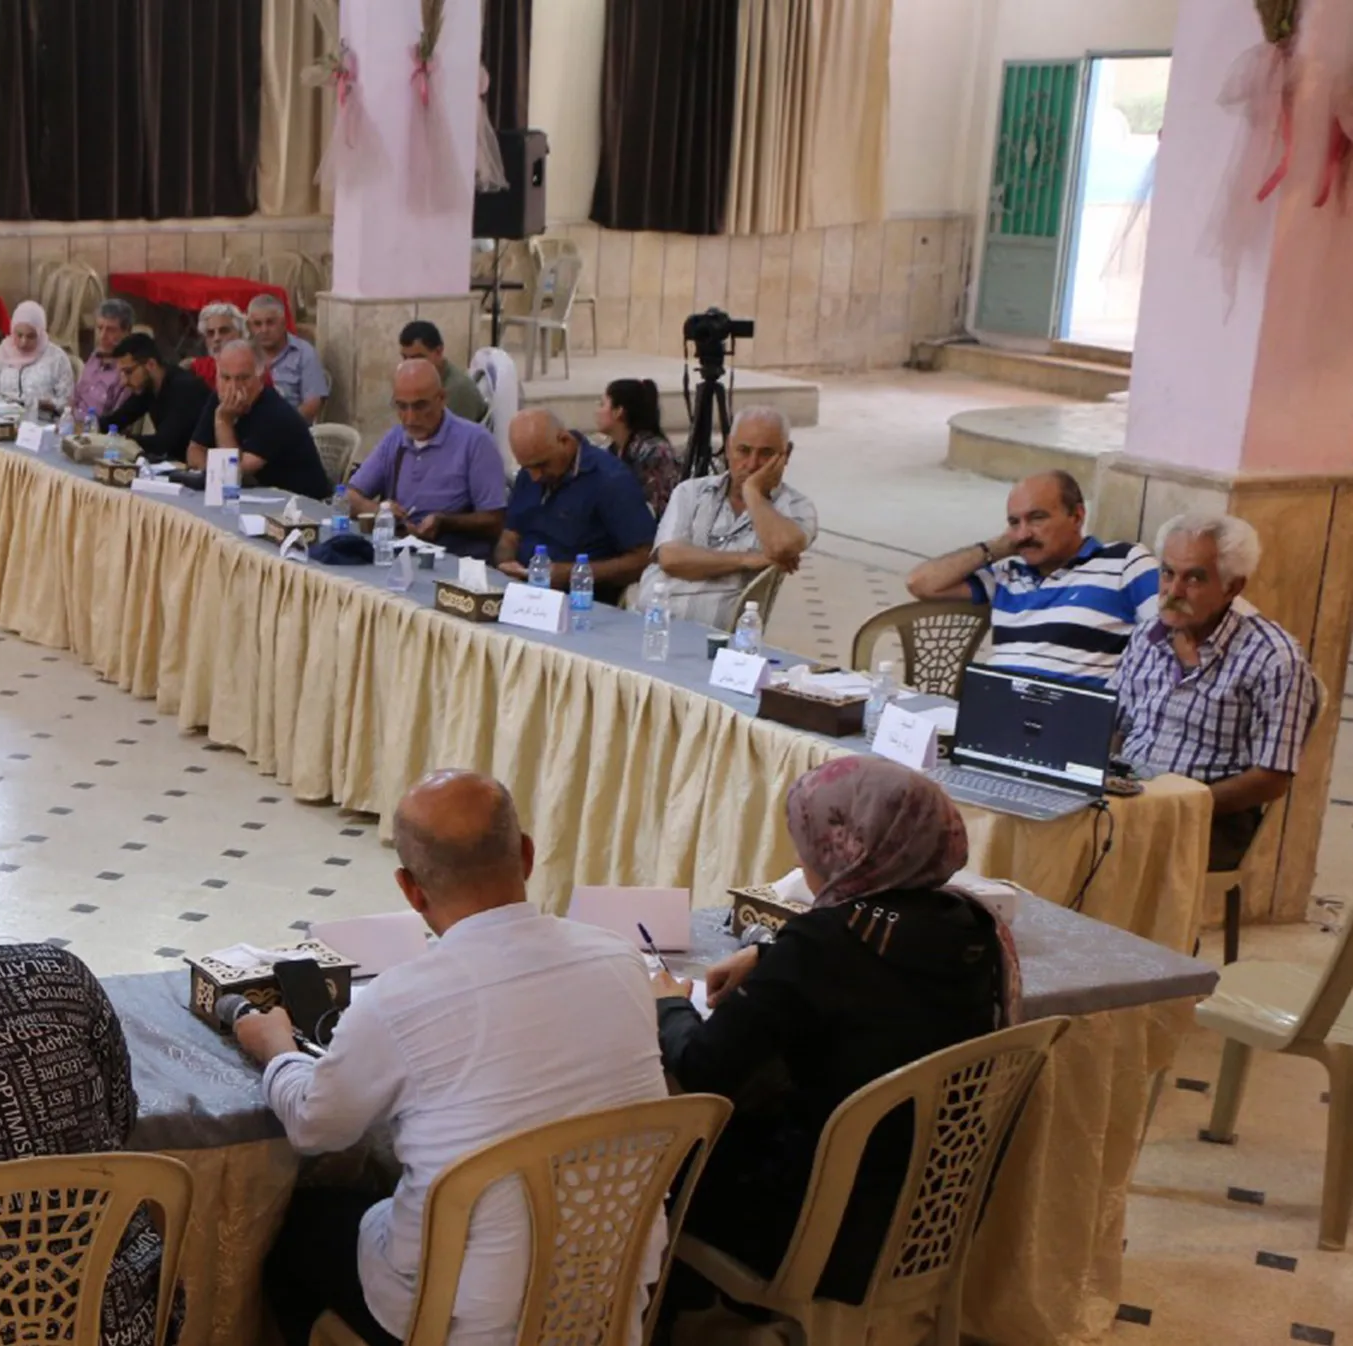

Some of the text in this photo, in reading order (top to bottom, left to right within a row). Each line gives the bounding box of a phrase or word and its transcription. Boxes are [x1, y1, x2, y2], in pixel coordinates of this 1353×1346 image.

[24, 1033, 74, 1057] HAPPY
[36, 1058, 84, 1082] LEISURE
[14, 1055, 48, 1122] TRIUMPH
[48, 1089, 73, 1107] BEST
